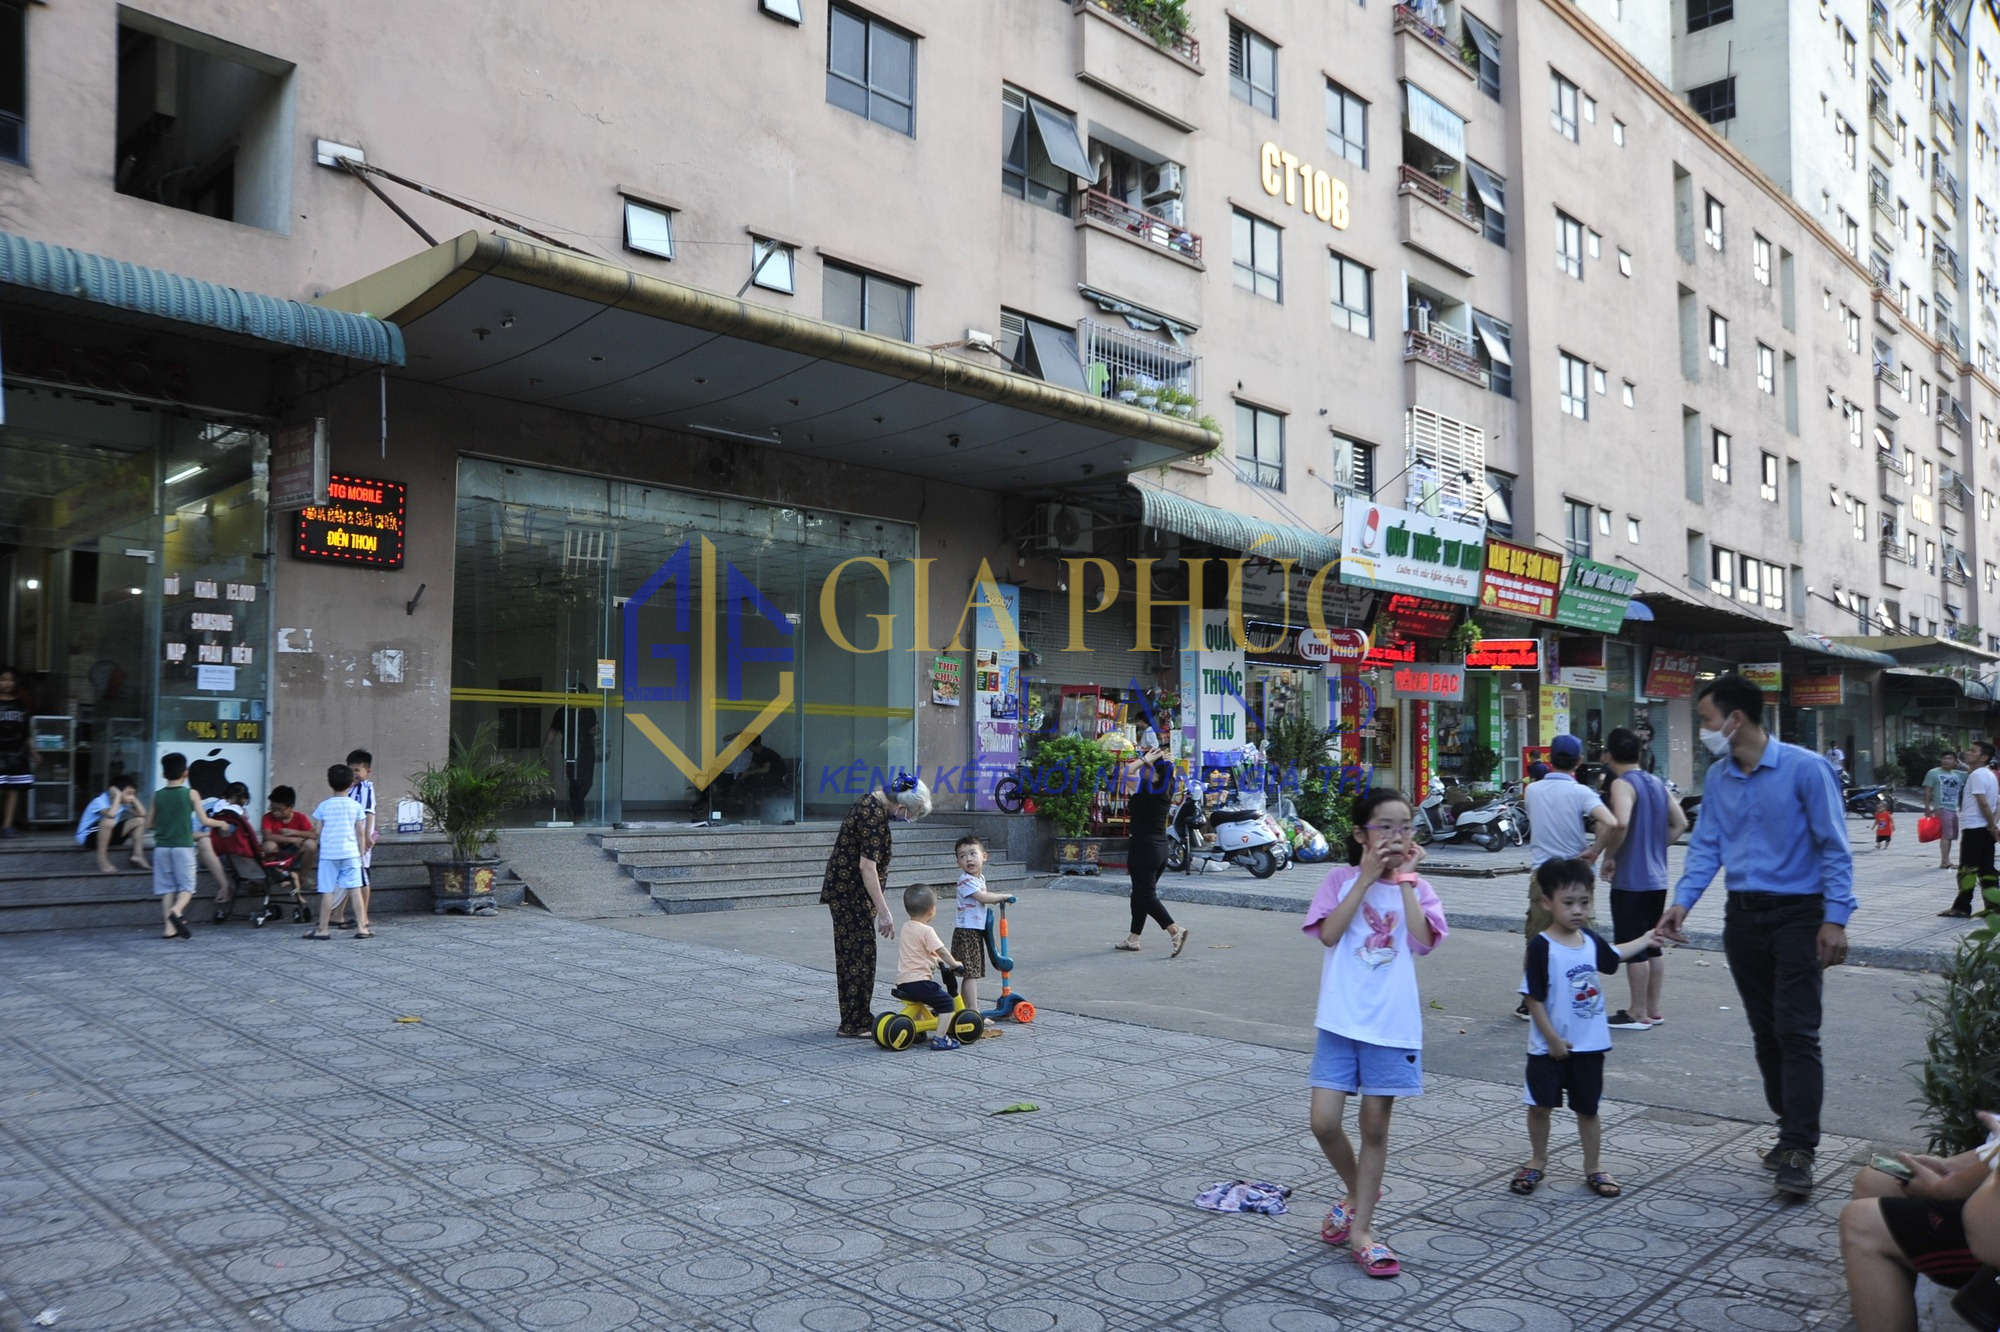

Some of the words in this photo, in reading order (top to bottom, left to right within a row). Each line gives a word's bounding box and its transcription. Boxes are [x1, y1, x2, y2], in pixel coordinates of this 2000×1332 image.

[1260, 140, 1350, 231] CT10B
[347, 485, 383, 504] MOBILE
[327, 527, 349, 550] ĐIỆN
[350, 532, 378, 554] THOẠI
[1488, 541, 1510, 573] VÀNG
[1509, 549, 1527, 579] BẠC
[226, 583, 256, 602] ICLOUD
[983, 591, 1014, 611] Bobby
[191, 612, 233, 632] SAMSUNG
[1331, 644, 1359, 659] KHÔI
[1202, 661, 1243, 697] THUỐC
[1431, 673, 1460, 697] BẠC
[236, 722, 258, 740] OPPO
[1210, 712, 1237, 741] THƯ
